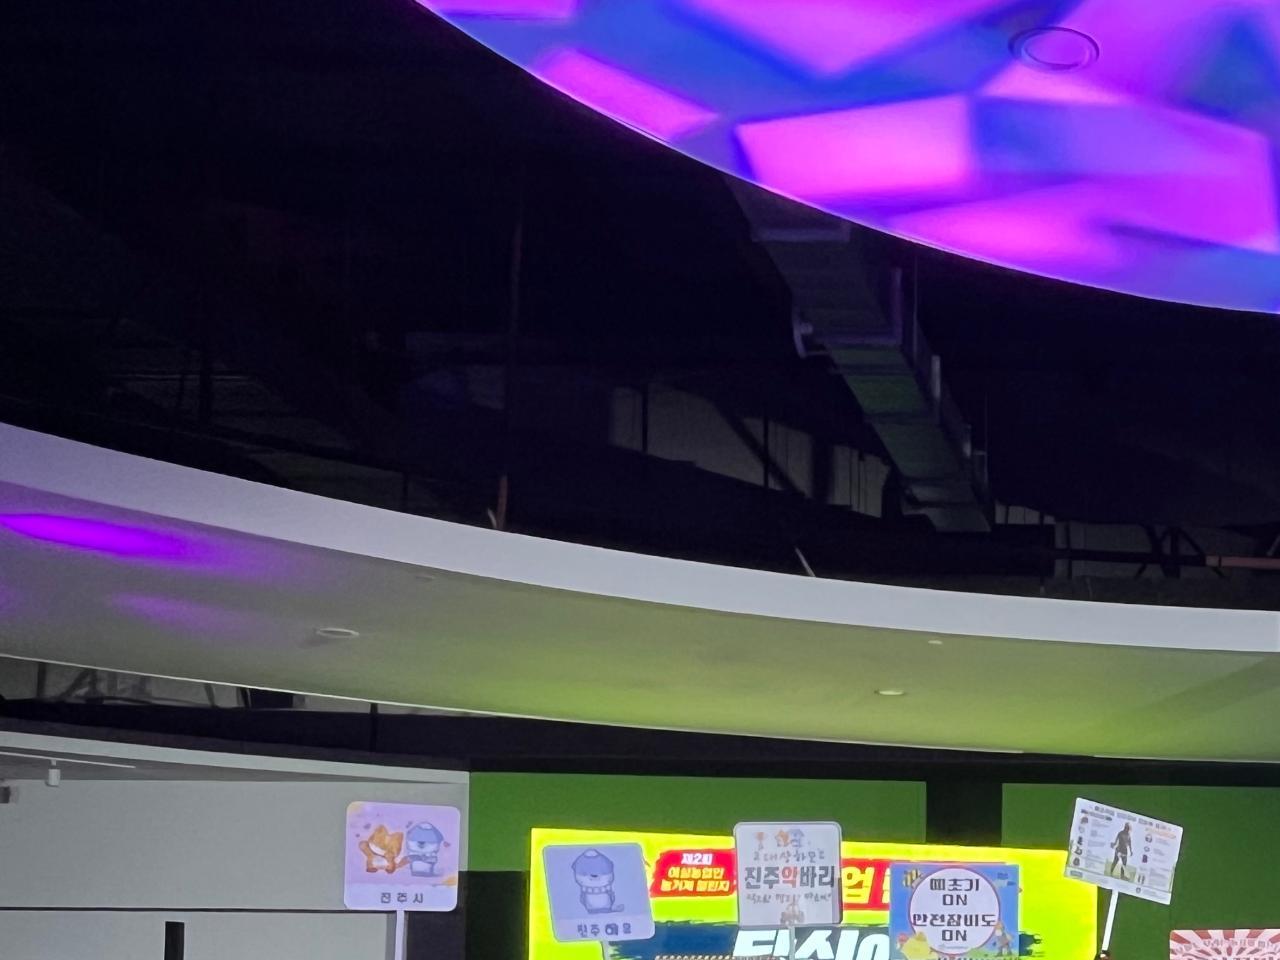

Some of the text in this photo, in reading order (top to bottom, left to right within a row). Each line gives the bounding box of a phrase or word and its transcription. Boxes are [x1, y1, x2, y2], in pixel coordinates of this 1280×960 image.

[744, 866, 835, 889] 진주약바리
[380, 892, 424, 904] 진주시
[942, 894, 968, 906] ON
[912, 913, 996, 927] 안전장비도
[942, 930, 968, 942] ON
